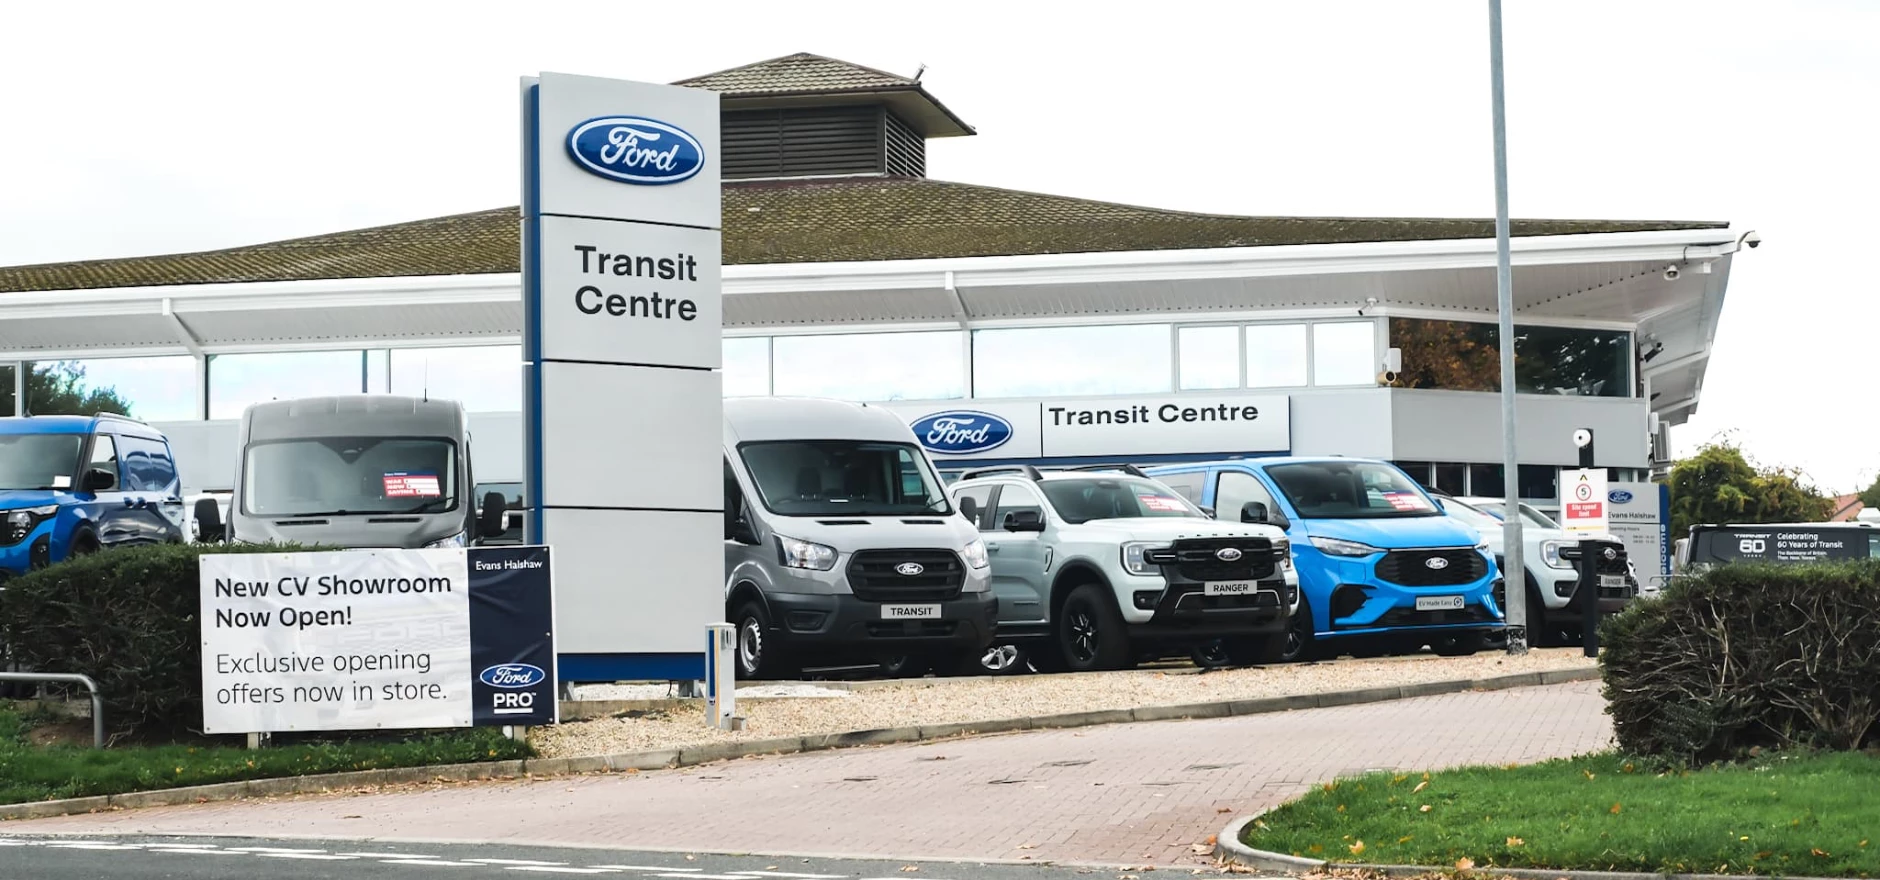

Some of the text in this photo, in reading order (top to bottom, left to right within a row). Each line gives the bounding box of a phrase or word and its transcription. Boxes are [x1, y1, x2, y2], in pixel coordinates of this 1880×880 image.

[600, 126, 680, 171] Ford
[574, 245, 697, 281] Transit
[575, 285, 697, 321] Centre
[1048, 402, 1259, 426] Transit Centre
[926, 417, 989, 446] Ford
[1581, 487, 1587, 496] 5
[1629, 512, 1656, 520] Halshaw
[1739, 539, 1766, 553] 60
[1777, 533, 1819, 541] Celebrating
[1777, 541, 1843, 549] 60 Years of Transit
[475, 559, 543, 571] Evans Halshaw
[215, 575, 452, 598] New CV Showroom
[1213, 583, 1249, 593] RANGER
[216, 606, 353, 630] Now Open!
[890, 607, 933, 616] TRANSIT
[217, 649, 431, 675] Exclusive opening
[492, 667, 533, 684] Ford
[217, 680, 447, 704] offers now in store.
